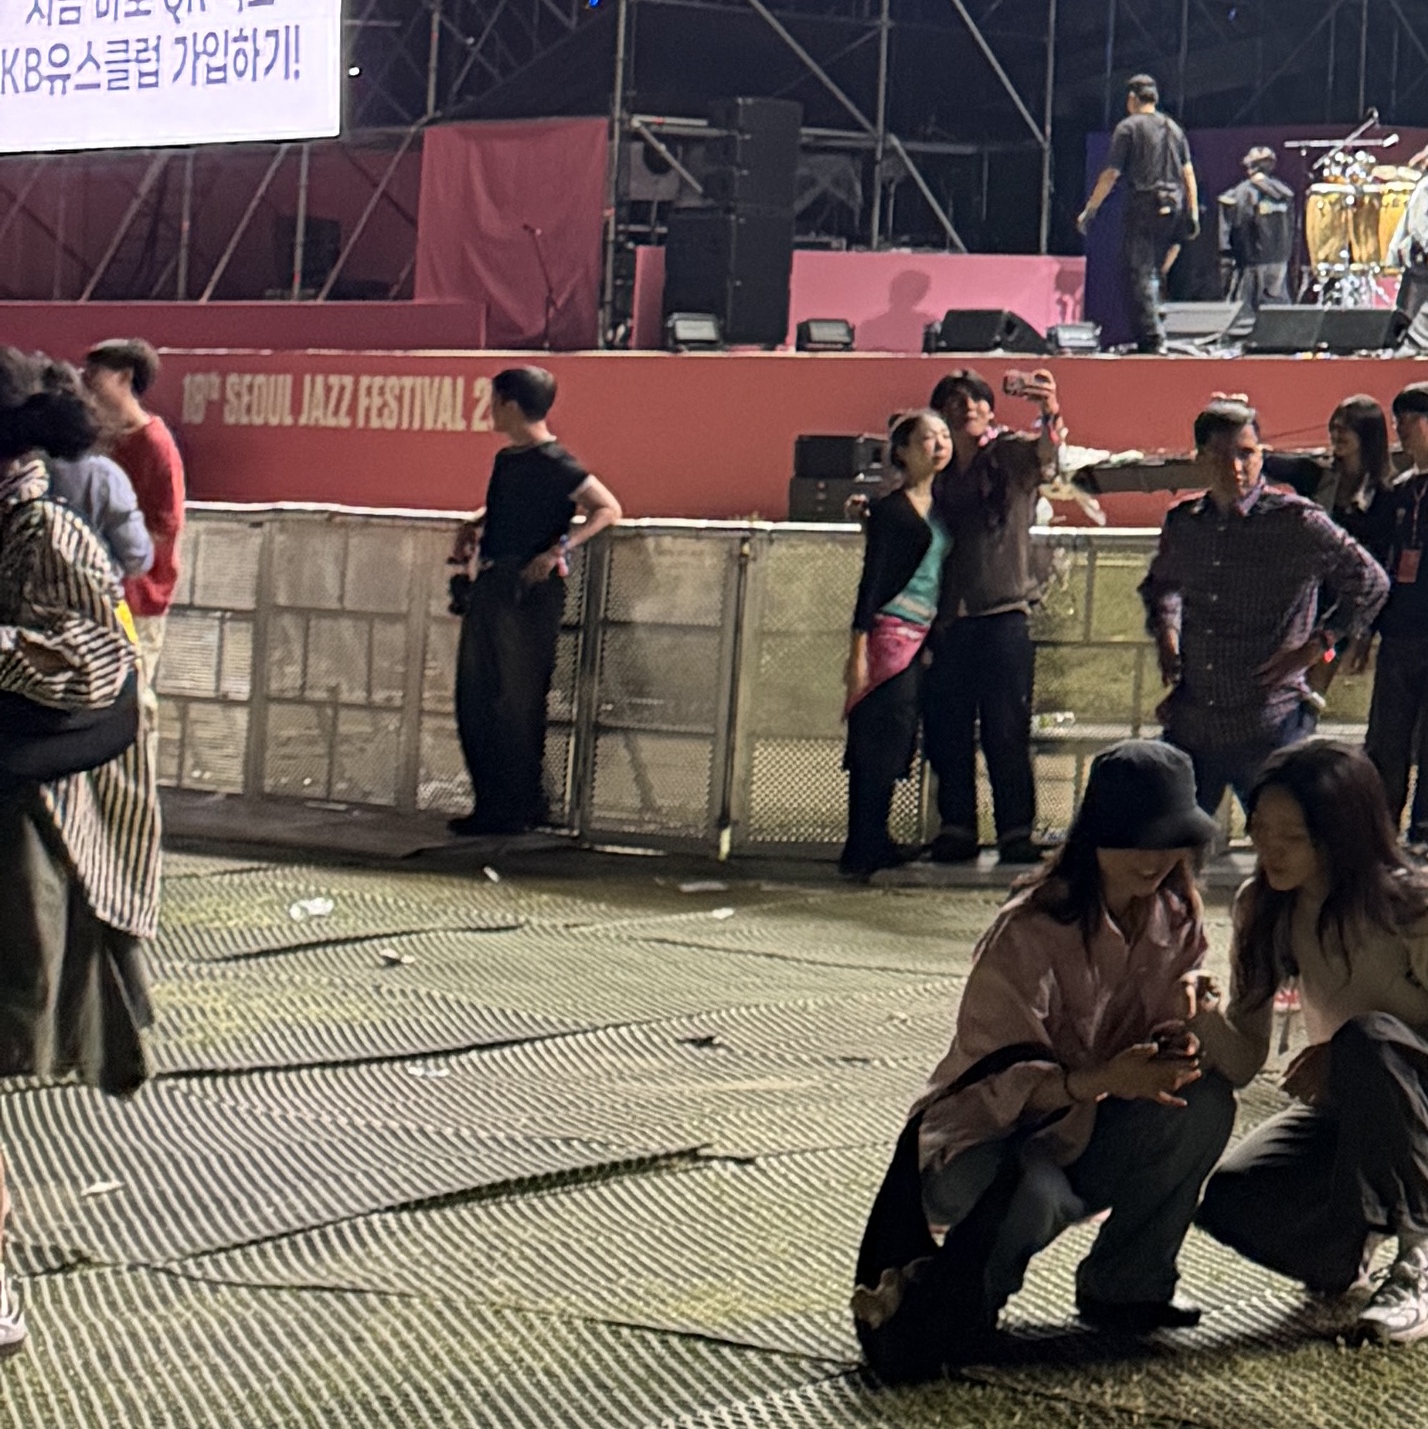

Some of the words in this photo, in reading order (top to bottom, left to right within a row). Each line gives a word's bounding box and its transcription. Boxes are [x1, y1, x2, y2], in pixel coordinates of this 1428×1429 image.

[0, 34, 163, 96] KB유스클럽
[171, 24, 300, 84] 가입하기!
[224, 373, 293, 426] SEOUL
[299, 373, 352, 429] JAZZ
[356, 375, 467, 431] FESTIVAL
